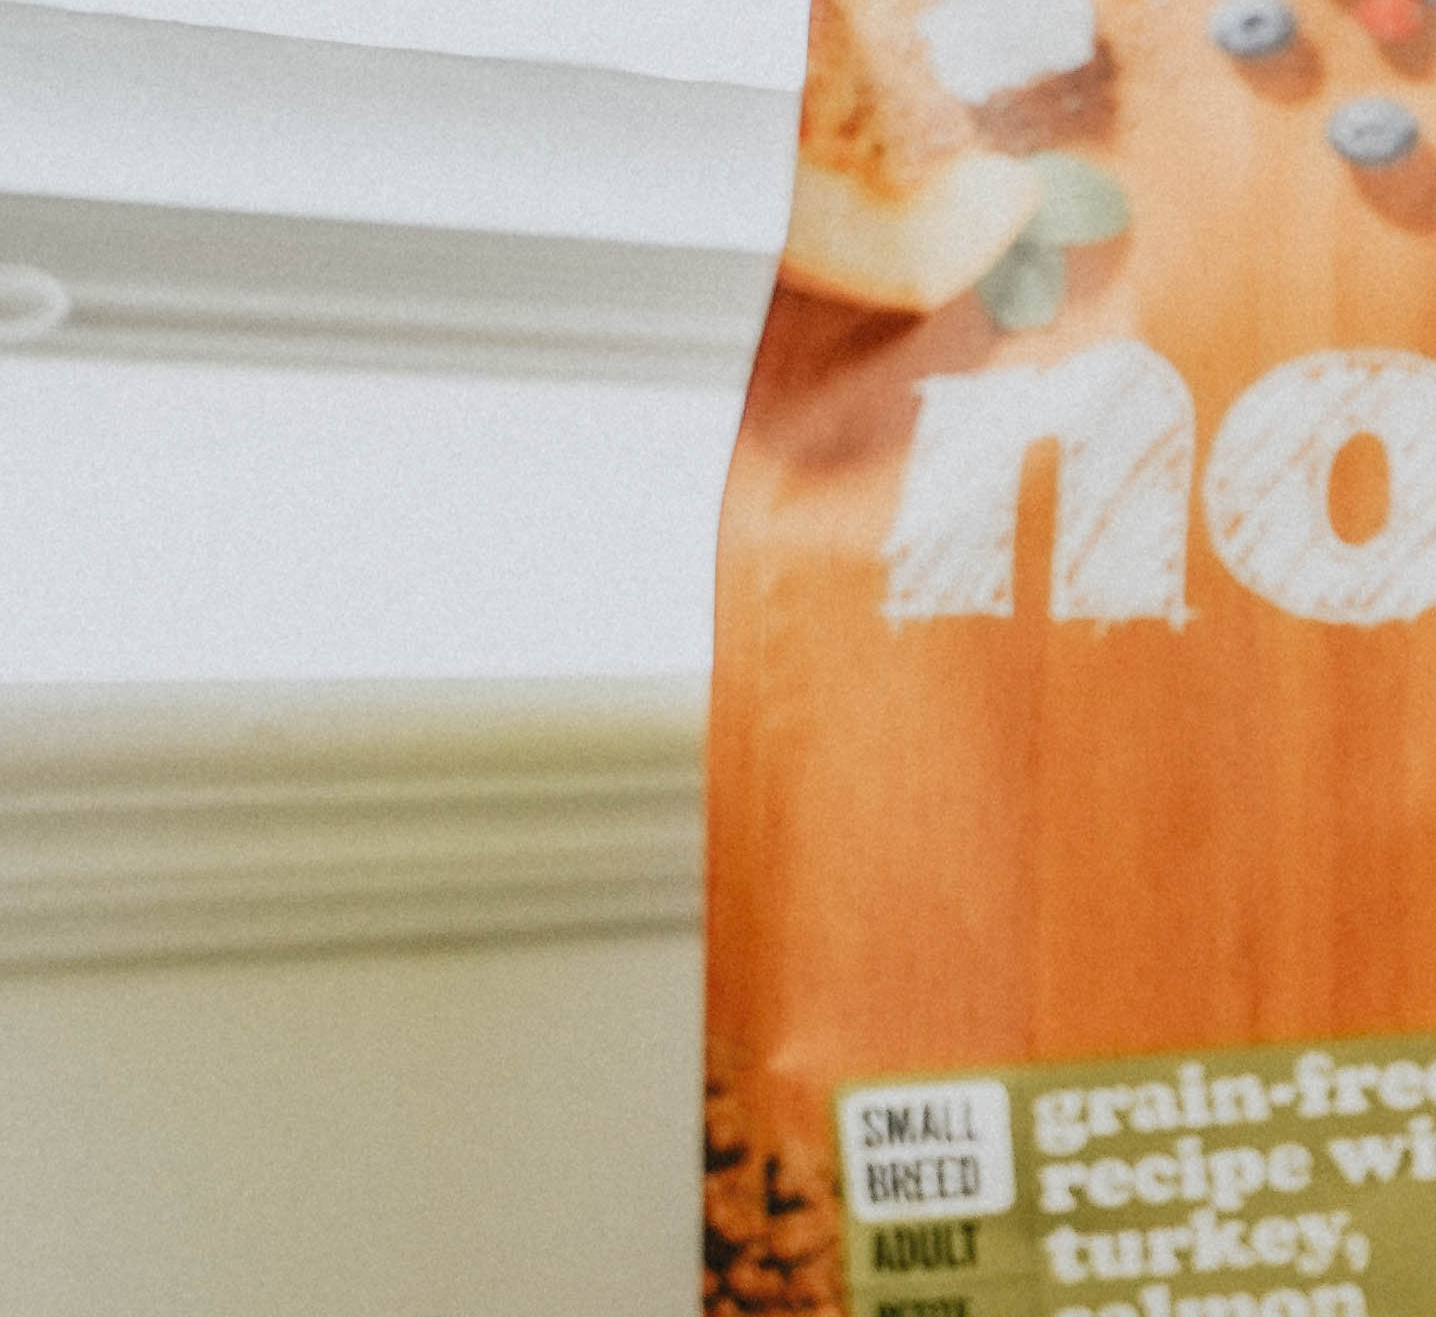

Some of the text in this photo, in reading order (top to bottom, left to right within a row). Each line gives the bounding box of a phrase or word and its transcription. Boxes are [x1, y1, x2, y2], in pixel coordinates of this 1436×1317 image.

[861, 1099, 977, 1148] SMALL
[865, 1154, 981, 1204] BREED
[1037, 1135, 1314, 1214] recipe
[872, 1222, 978, 1273] ADULT
[1045, 1206, 1370, 1282] turkey,
